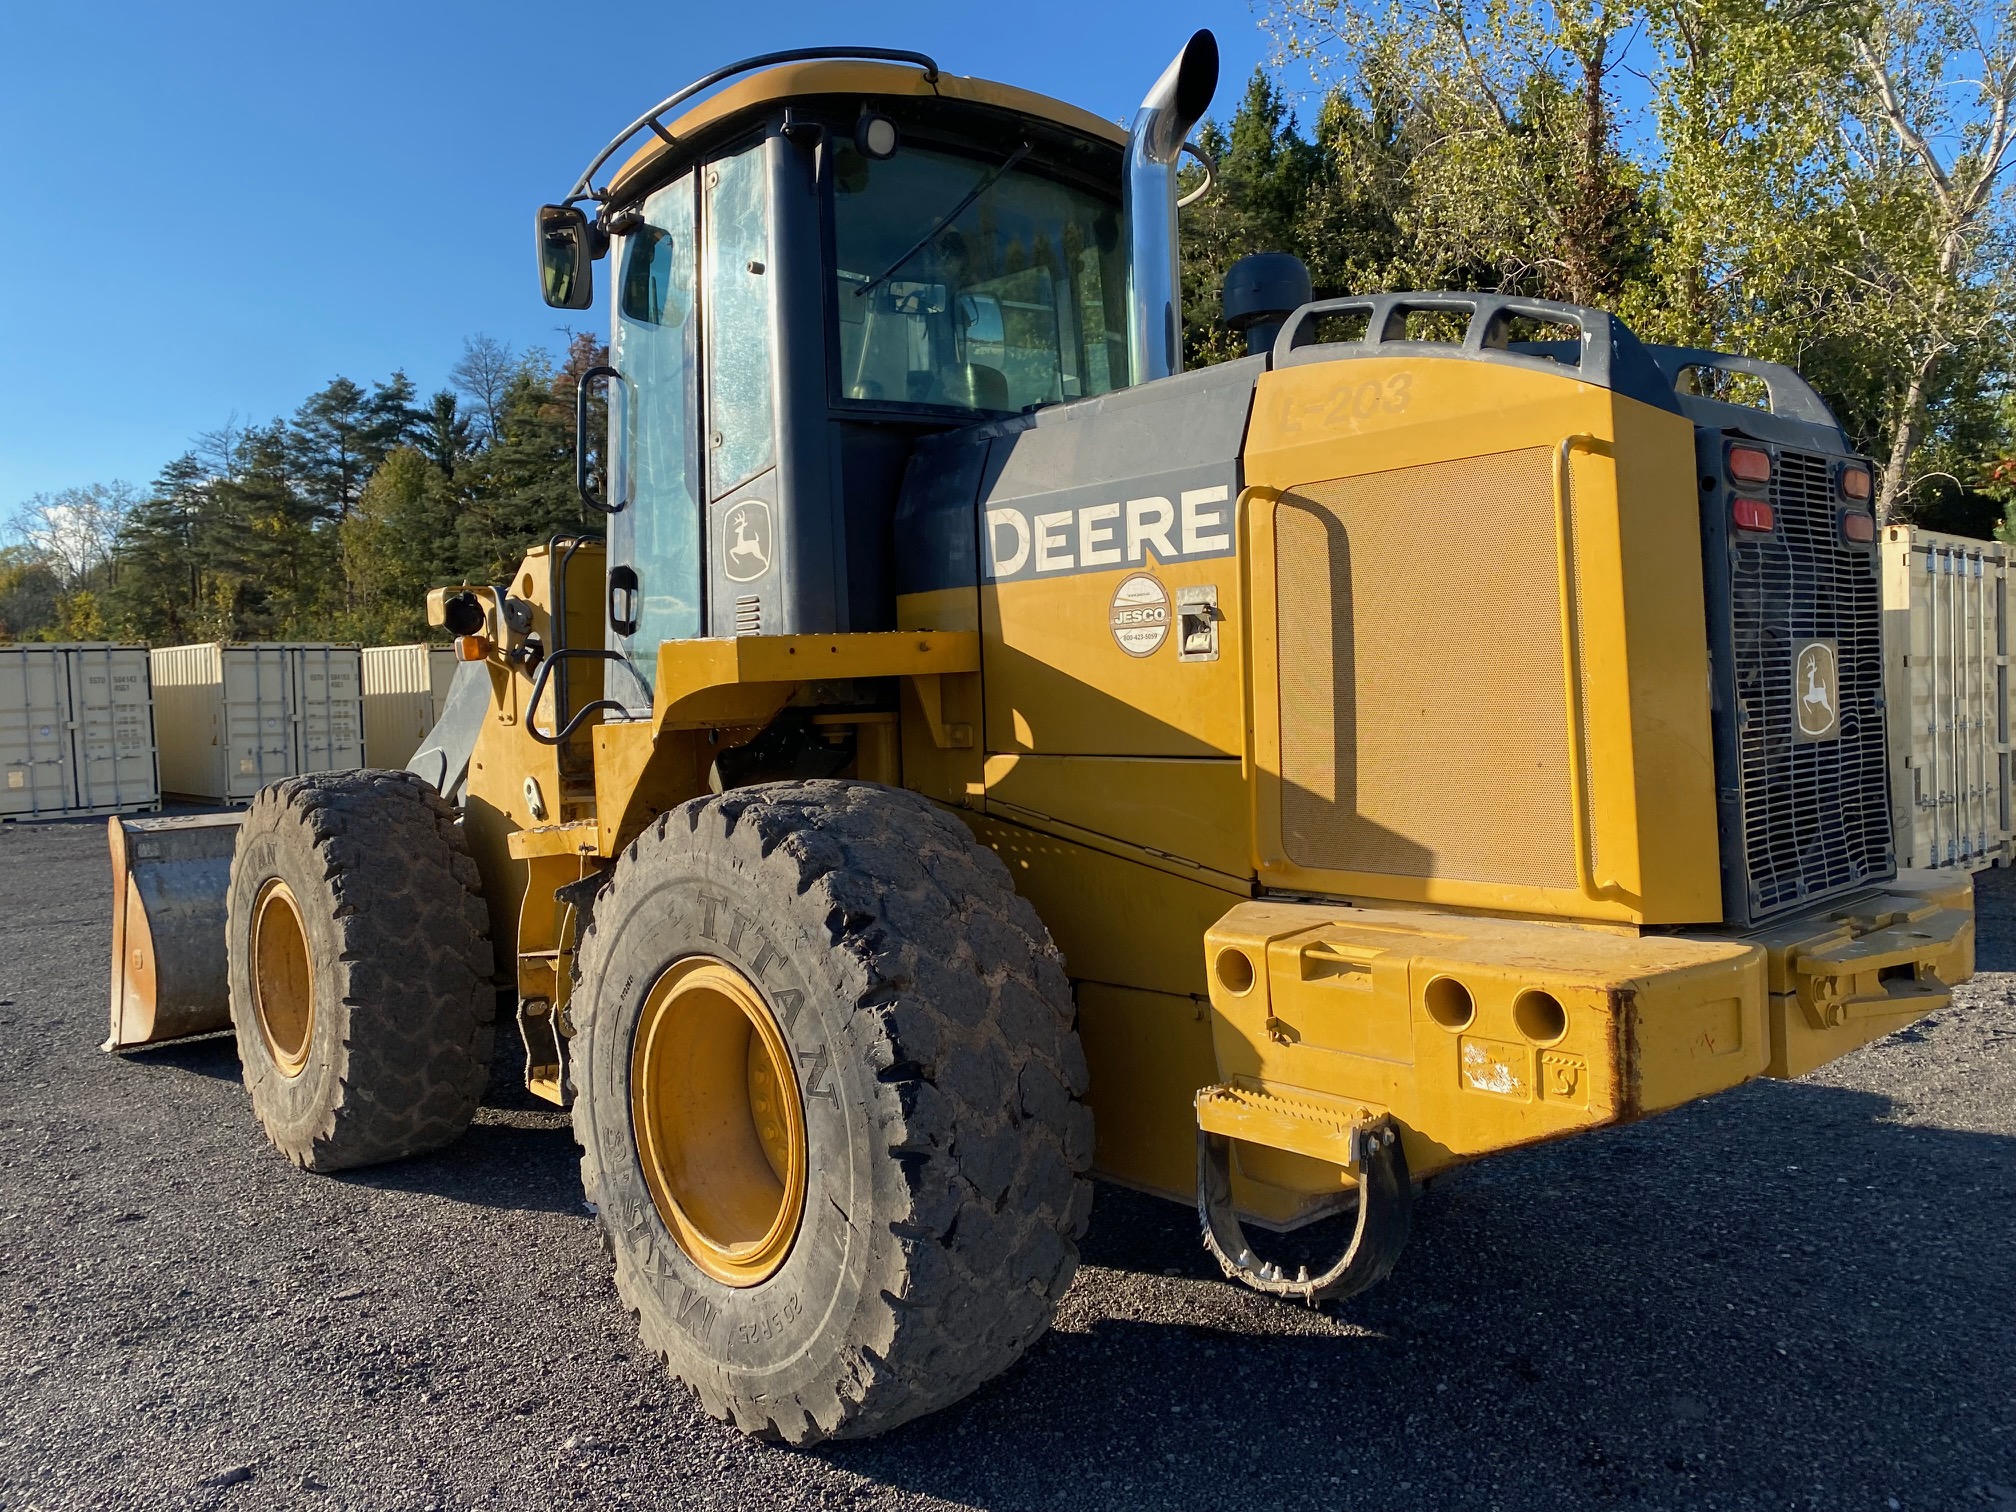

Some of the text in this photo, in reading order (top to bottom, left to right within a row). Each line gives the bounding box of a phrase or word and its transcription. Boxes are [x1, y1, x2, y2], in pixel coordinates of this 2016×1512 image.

[984, 485, 1230, 578] DEERE
[1114, 607, 1167, 625] JESCO
[1123, 632, 1158, 642] 800-423-5059
[239, 841, 278, 909] TITAN
[696, 890, 839, 1110] TITAN
